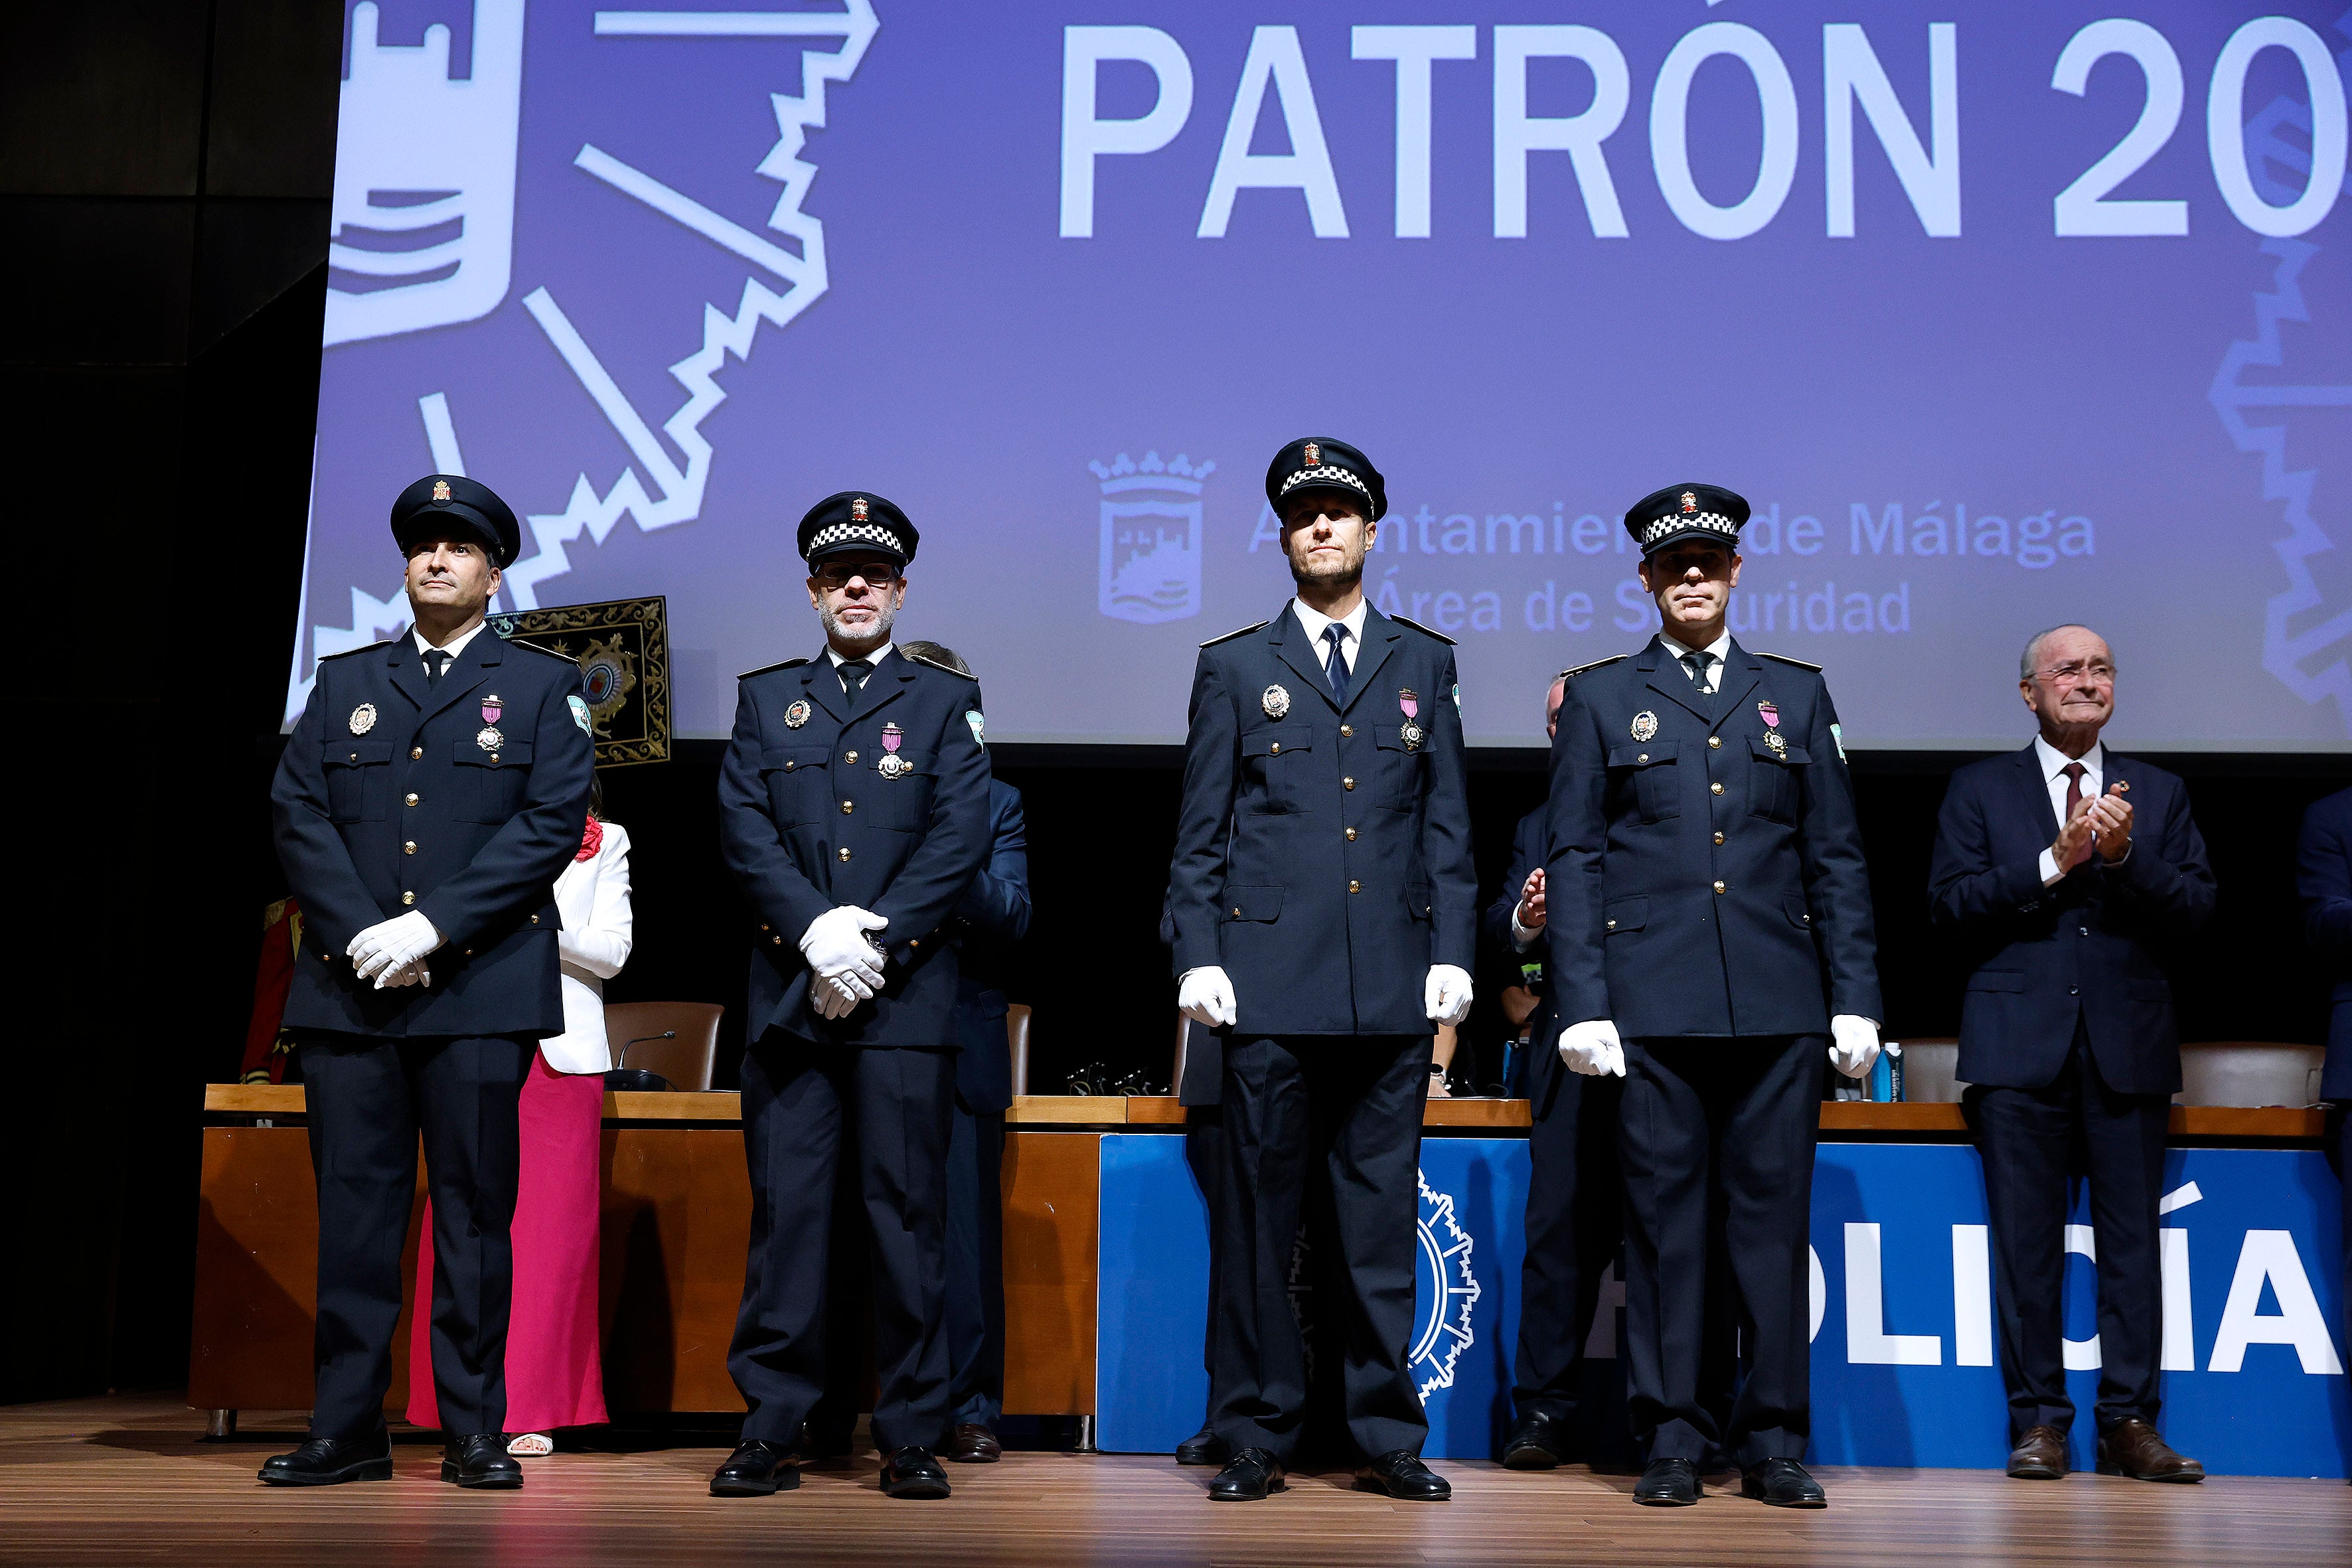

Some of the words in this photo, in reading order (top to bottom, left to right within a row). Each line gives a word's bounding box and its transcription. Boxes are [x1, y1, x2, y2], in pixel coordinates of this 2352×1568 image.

[1059, 0, 1962, 242] PATRÓN
[1248, 501, 1631, 554] Antamie
[1746, 503, 1824, 556] de
[1849, 499, 2096, 569] Málaga
[1376, 566, 1502, 631] Área
[1528, 580, 1592, 632] de
[1613, 580, 1911, 633] Suridad
[1583, 1180, 2345, 1374] LIÍA
